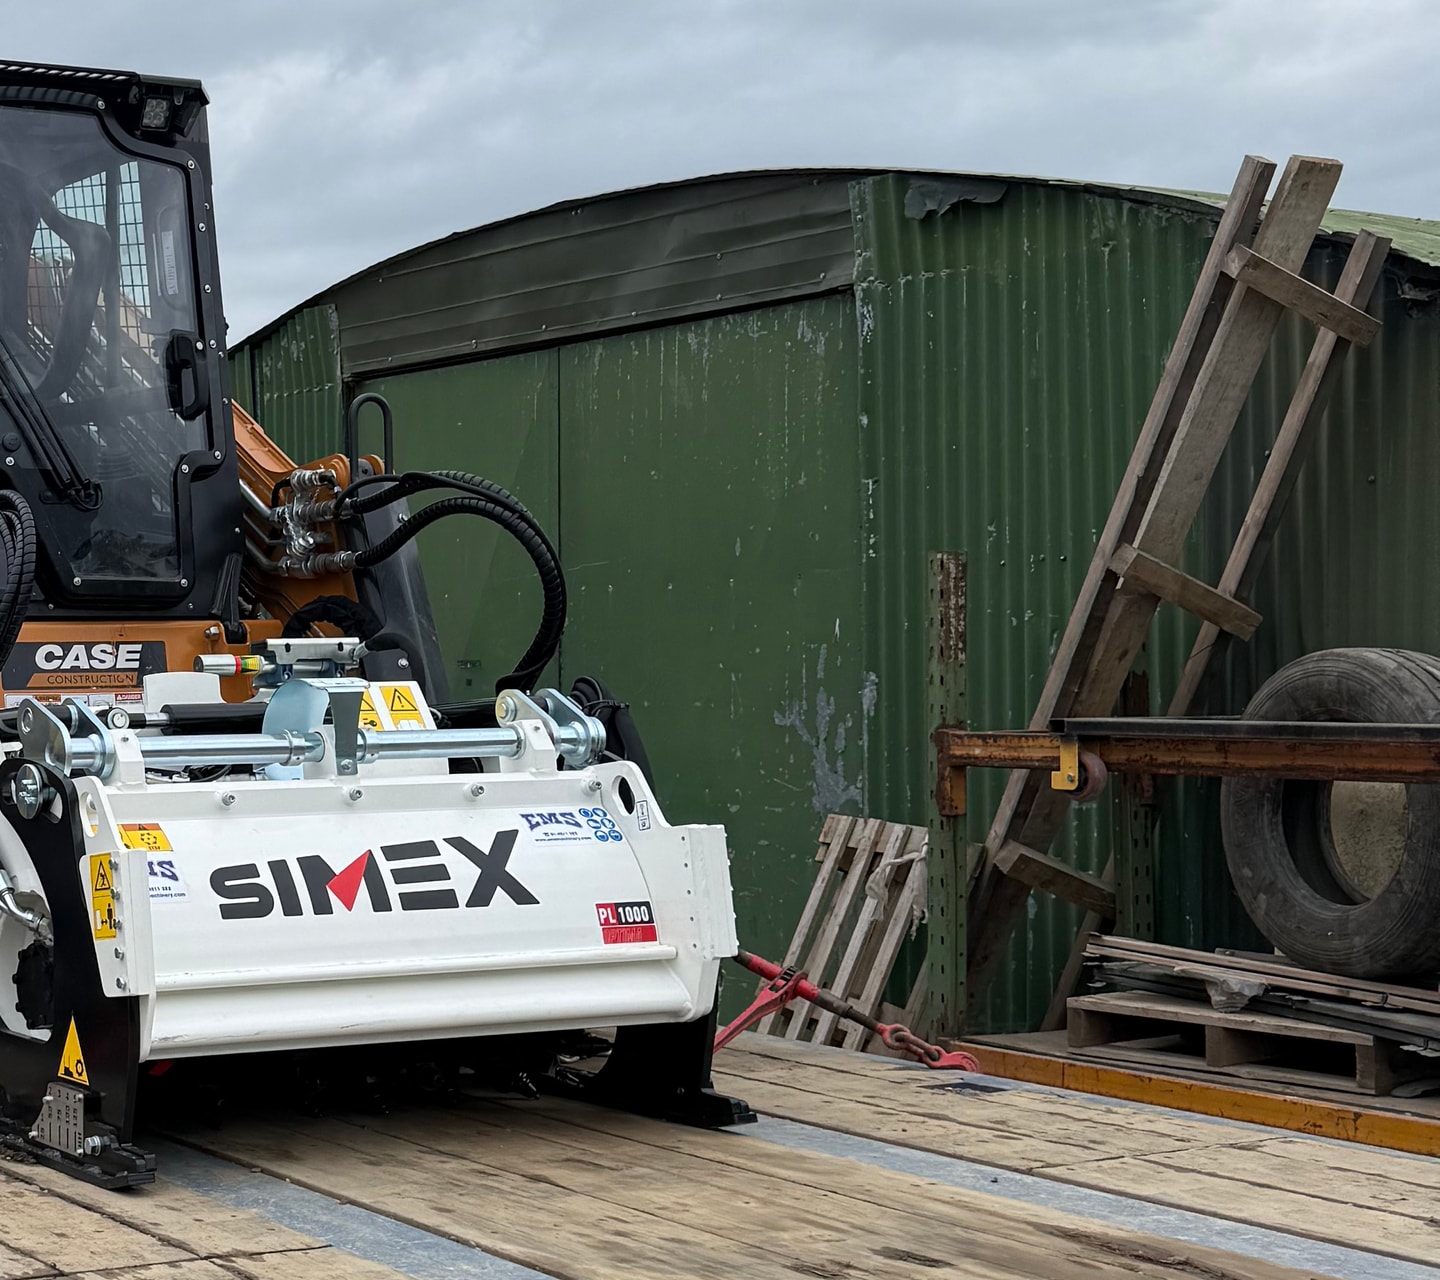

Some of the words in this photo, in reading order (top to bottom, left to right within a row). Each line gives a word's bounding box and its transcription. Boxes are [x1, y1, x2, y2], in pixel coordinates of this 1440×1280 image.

[34, 644, 143, 670] CASE
[47, 674, 135, 686] CONSTRUCTION
[520, 811, 583, 831] EMS
[209, 828, 541, 920] SIMEX
[598, 907, 617, 924] PL
[618, 906, 649, 923] 1000
